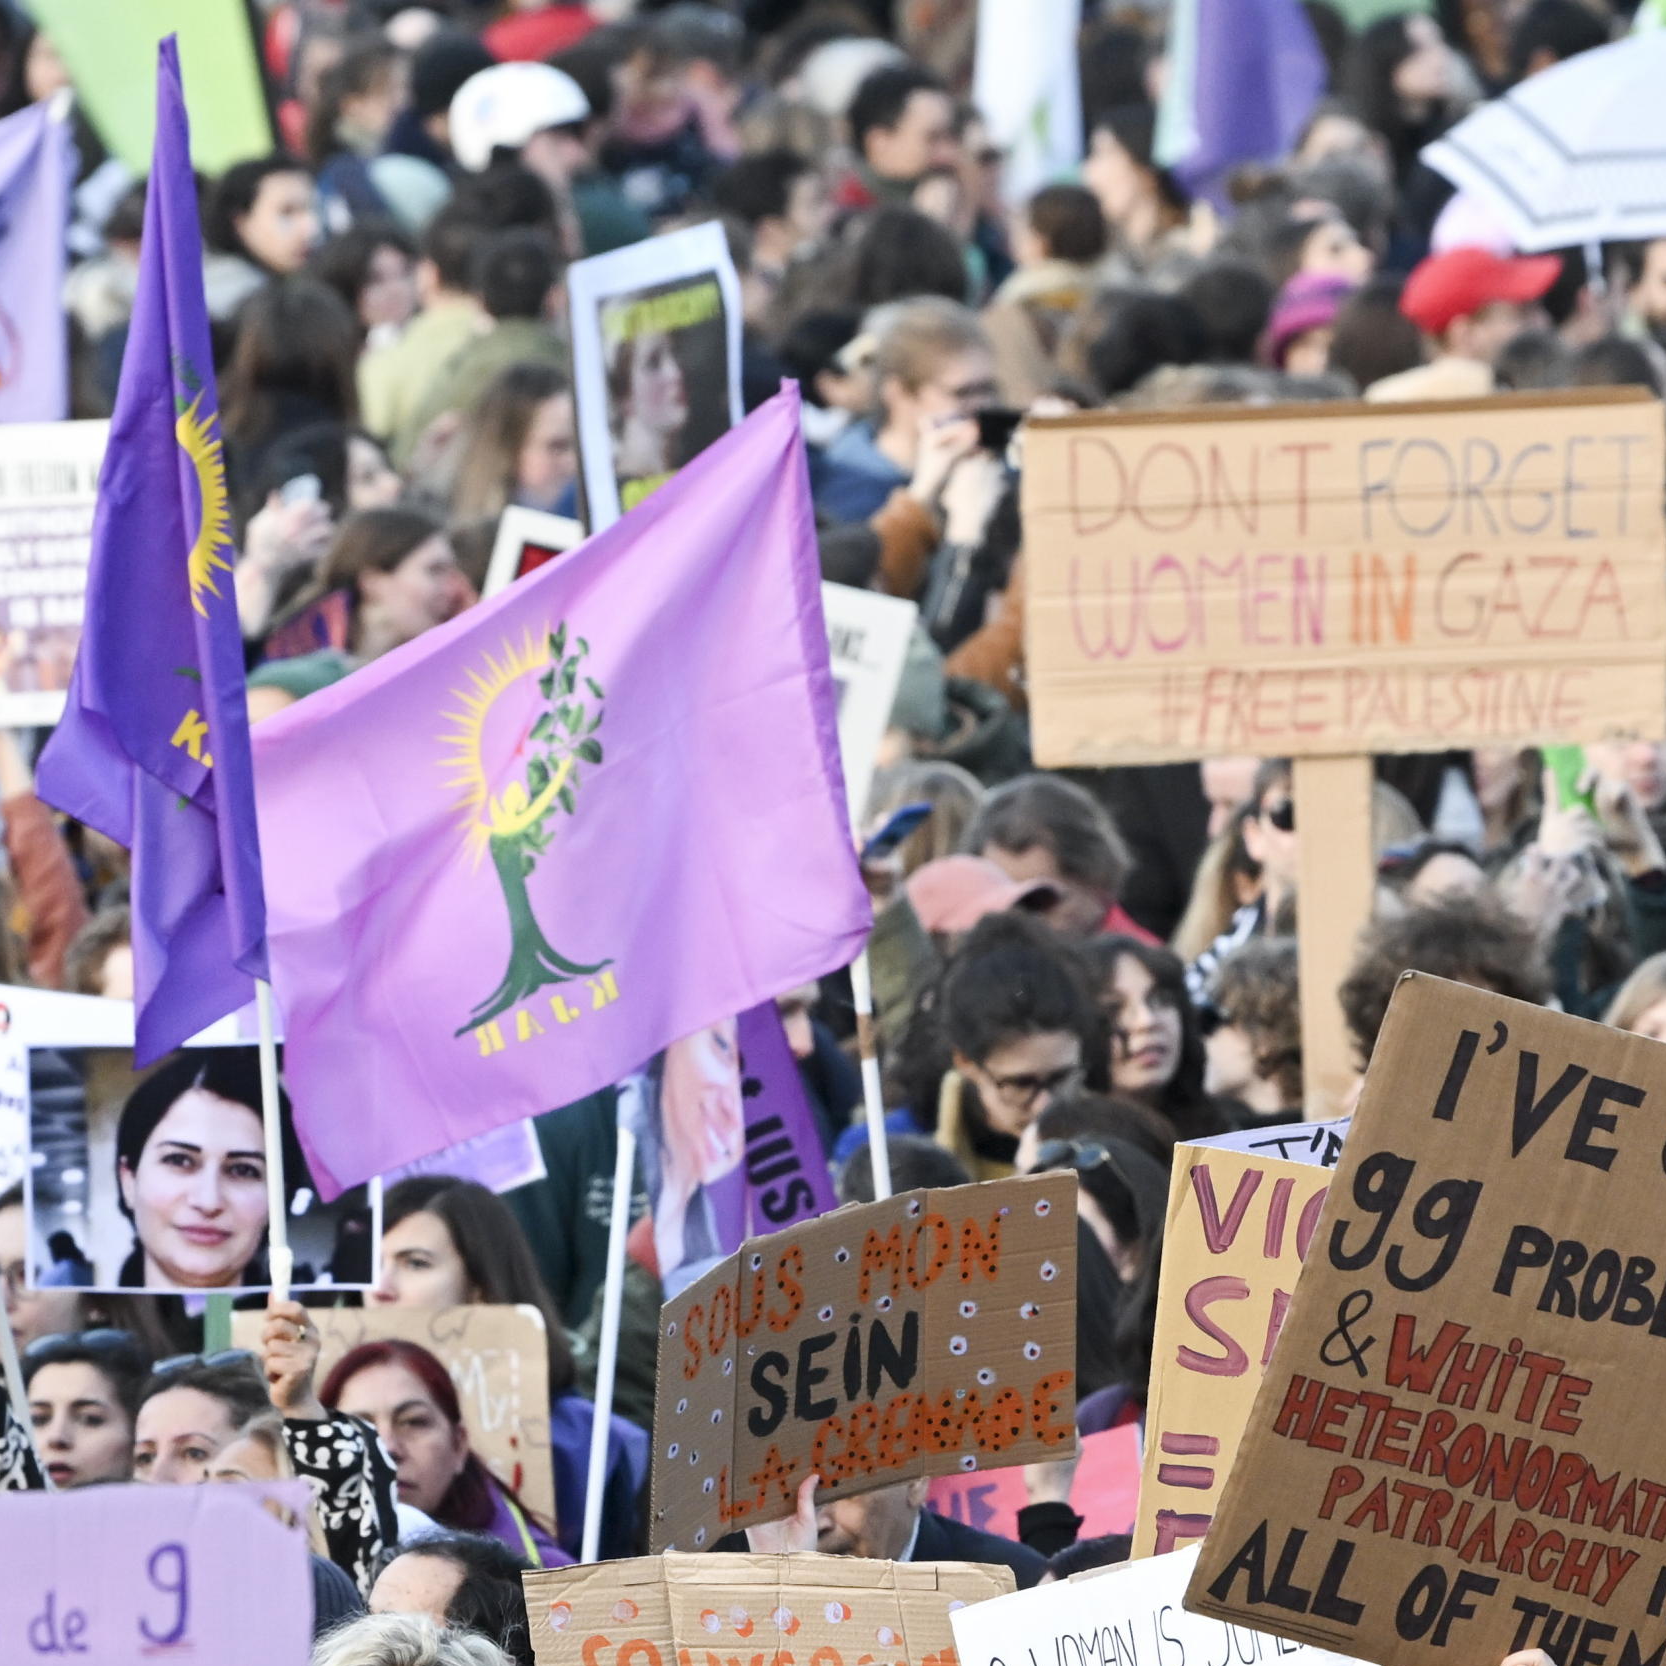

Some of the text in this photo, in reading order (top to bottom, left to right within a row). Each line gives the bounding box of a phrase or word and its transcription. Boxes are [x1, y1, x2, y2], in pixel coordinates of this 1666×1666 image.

[1358, 434, 1653, 540] FORGET
[1069, 551, 1631, 660] WOMEN IN GAZA
[1430, 1018, 1647, 1173] I'VE
[682, 1209, 1004, 1382] SOUS MON
[1318, 1288, 1378, 1379] &
[717, 1441, 802, 1524] LA
[1317, 1464, 1642, 1609] PATRIARCHY
[27, 1591, 91, 1656] de
[137, 1540, 191, 1649] 9
[1206, 1517, 1366, 1628] ALL
[1392, 1561, 1500, 1651] OF
